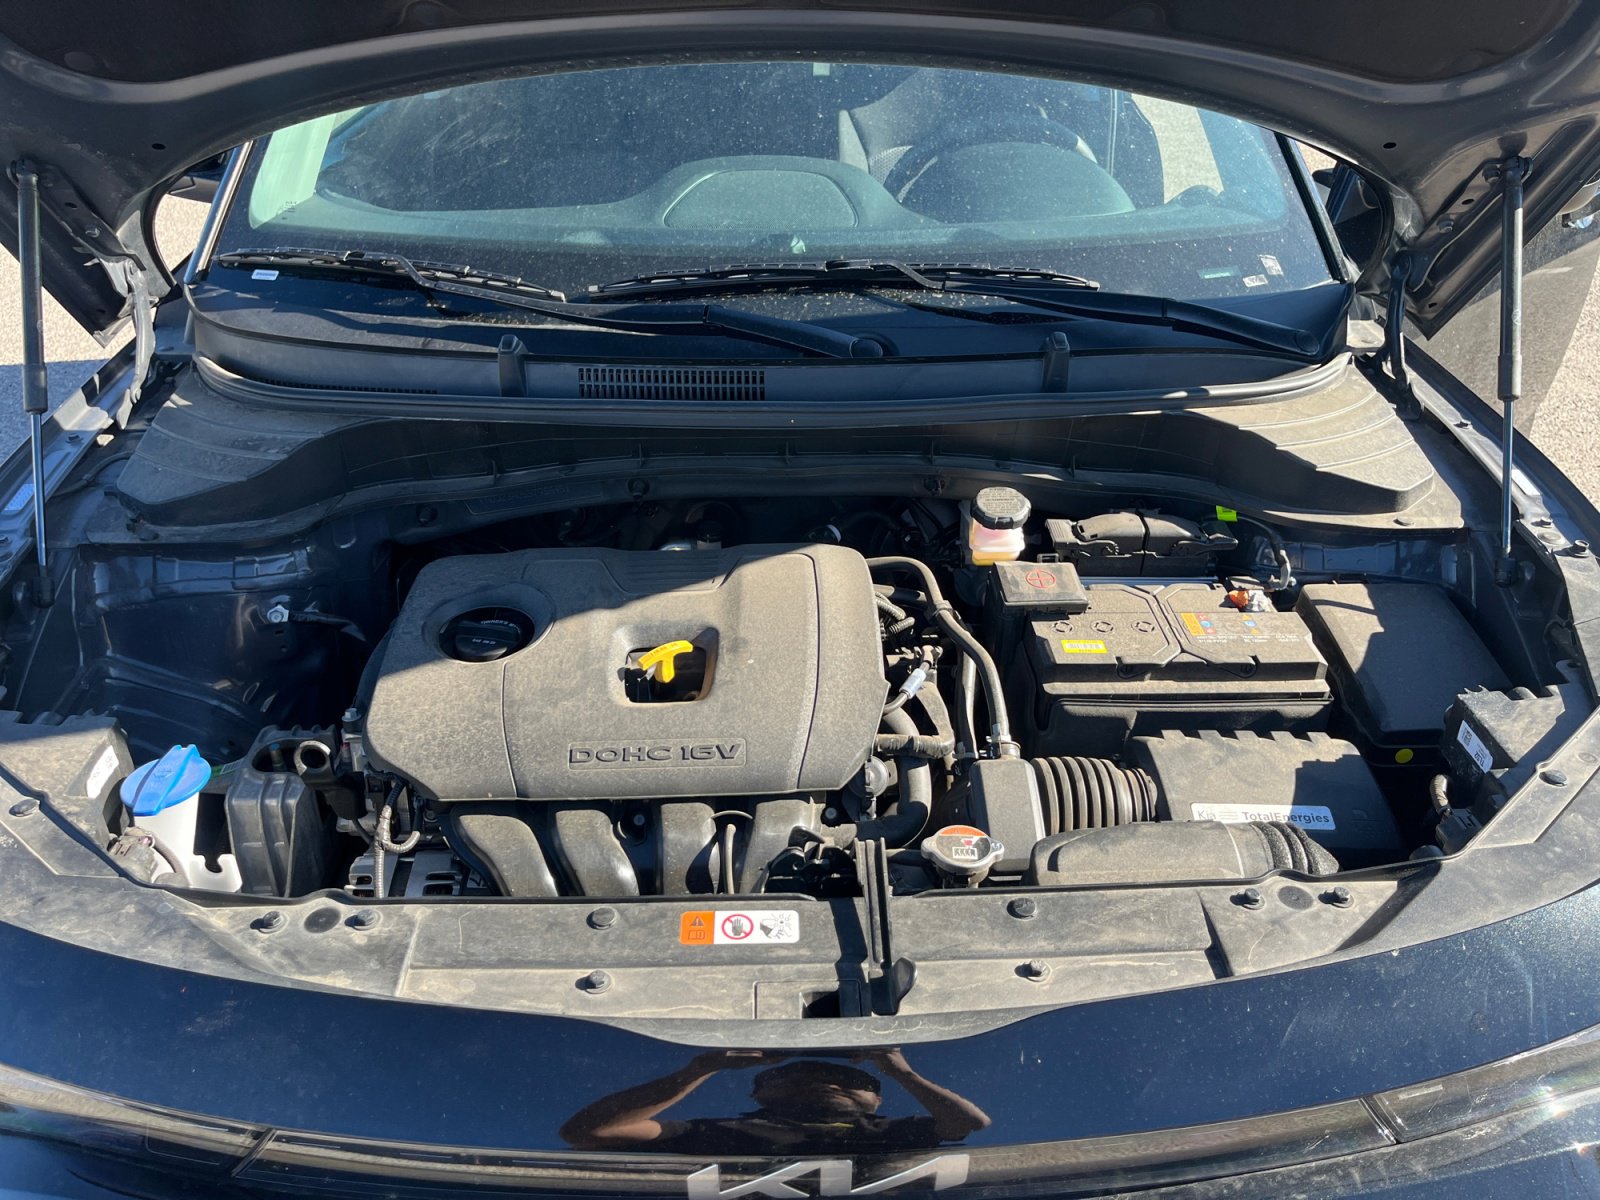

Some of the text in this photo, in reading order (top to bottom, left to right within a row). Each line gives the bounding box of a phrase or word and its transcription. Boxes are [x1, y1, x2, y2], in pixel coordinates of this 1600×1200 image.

[569, 743, 742, 764] DOHC 16V
[1197, 809, 1330, 825] Kia TotalEnergies
[687, 1153, 970, 1200] KIA
